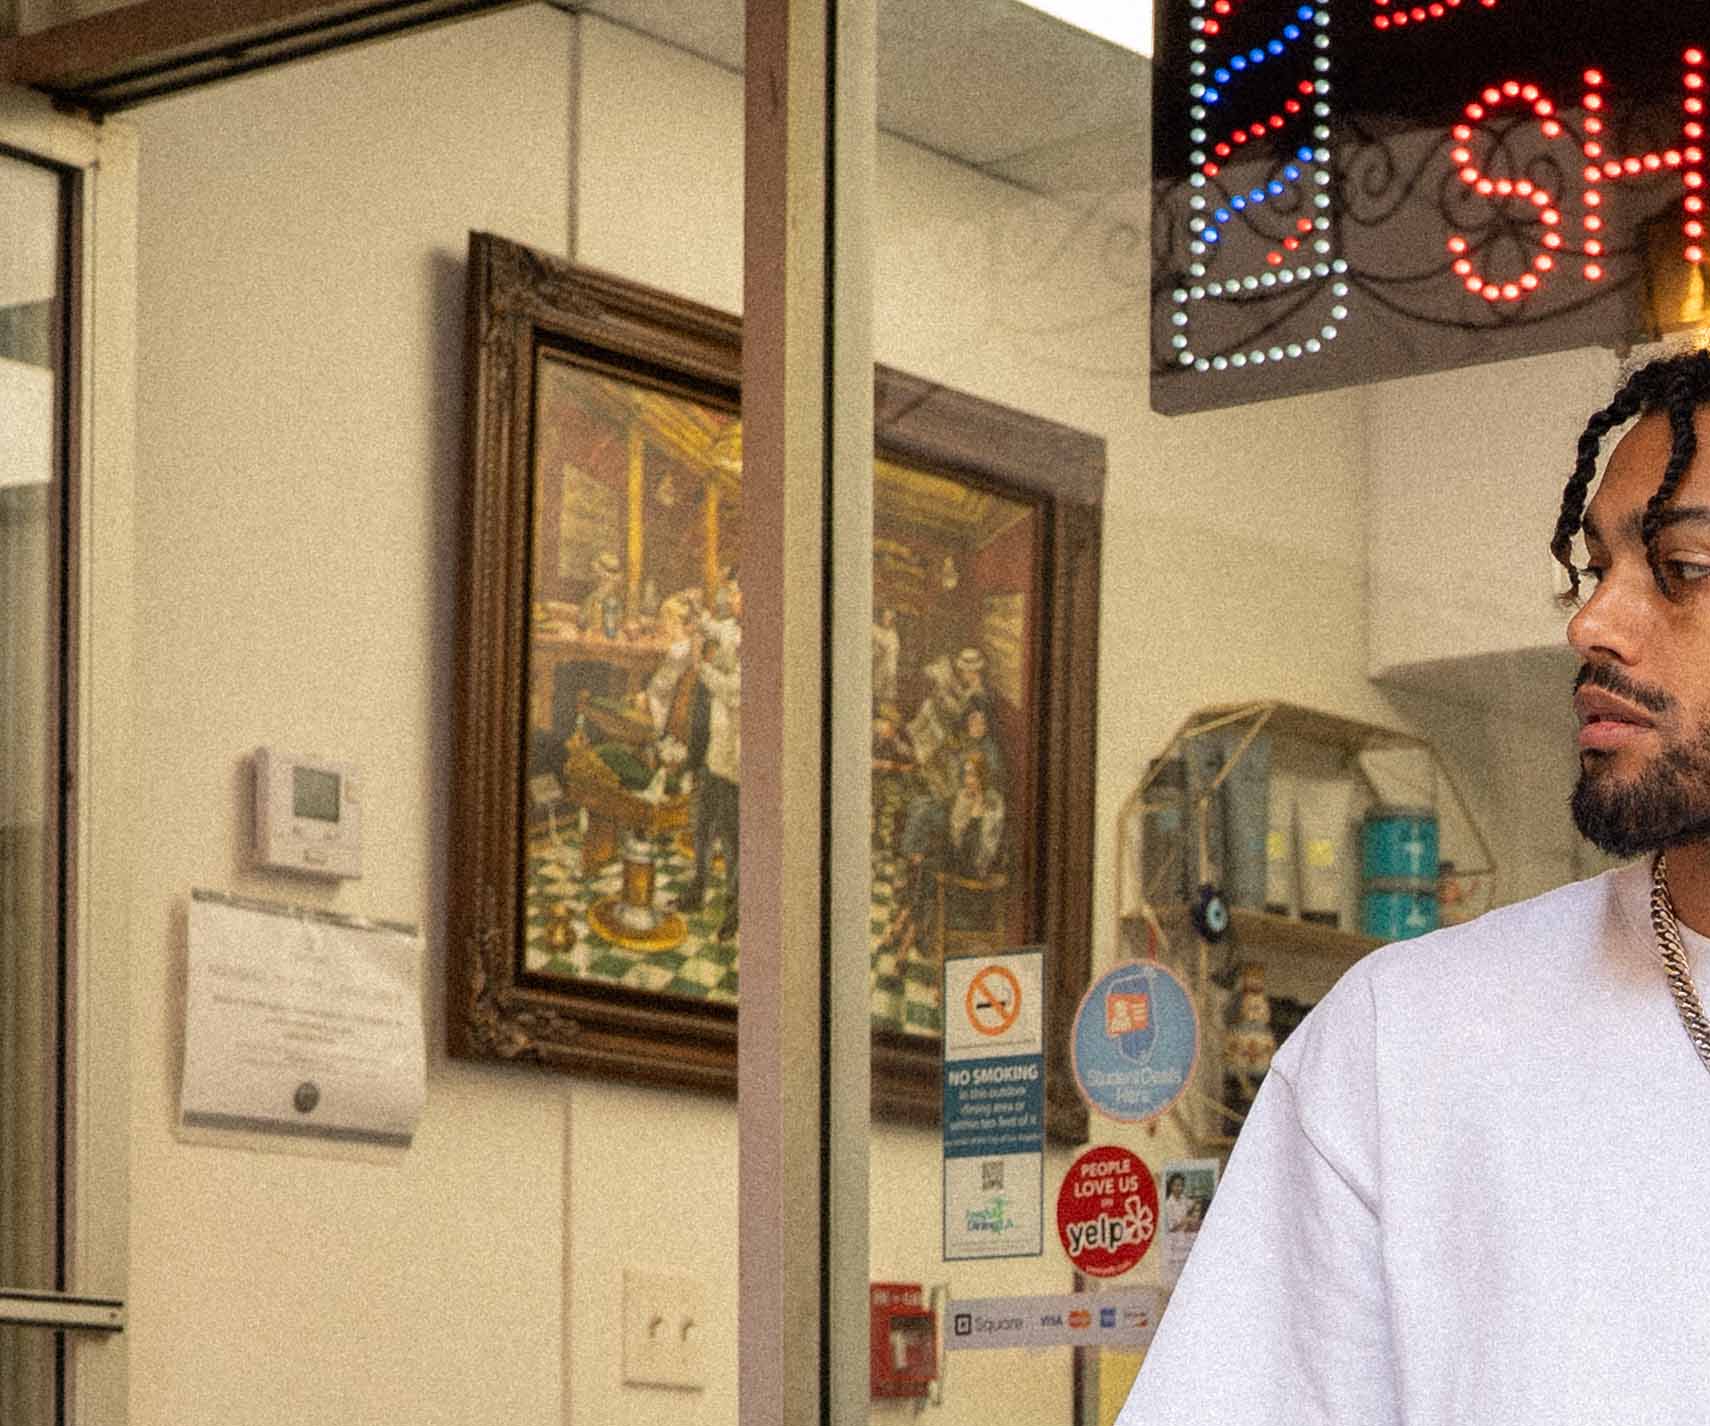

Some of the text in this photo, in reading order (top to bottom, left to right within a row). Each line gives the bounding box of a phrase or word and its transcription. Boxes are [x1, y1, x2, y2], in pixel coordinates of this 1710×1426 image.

[949, 1064, 1039, 1087] NO SMOKING
[1080, 1159, 1131, 1177] PEOPLE
[1074, 1176, 1139, 1198] LOVE US
[1068, 1215, 1125, 1254] yelp
[974, 1316, 1023, 1334] Square
[1040, 1315, 1063, 1327] VISA
